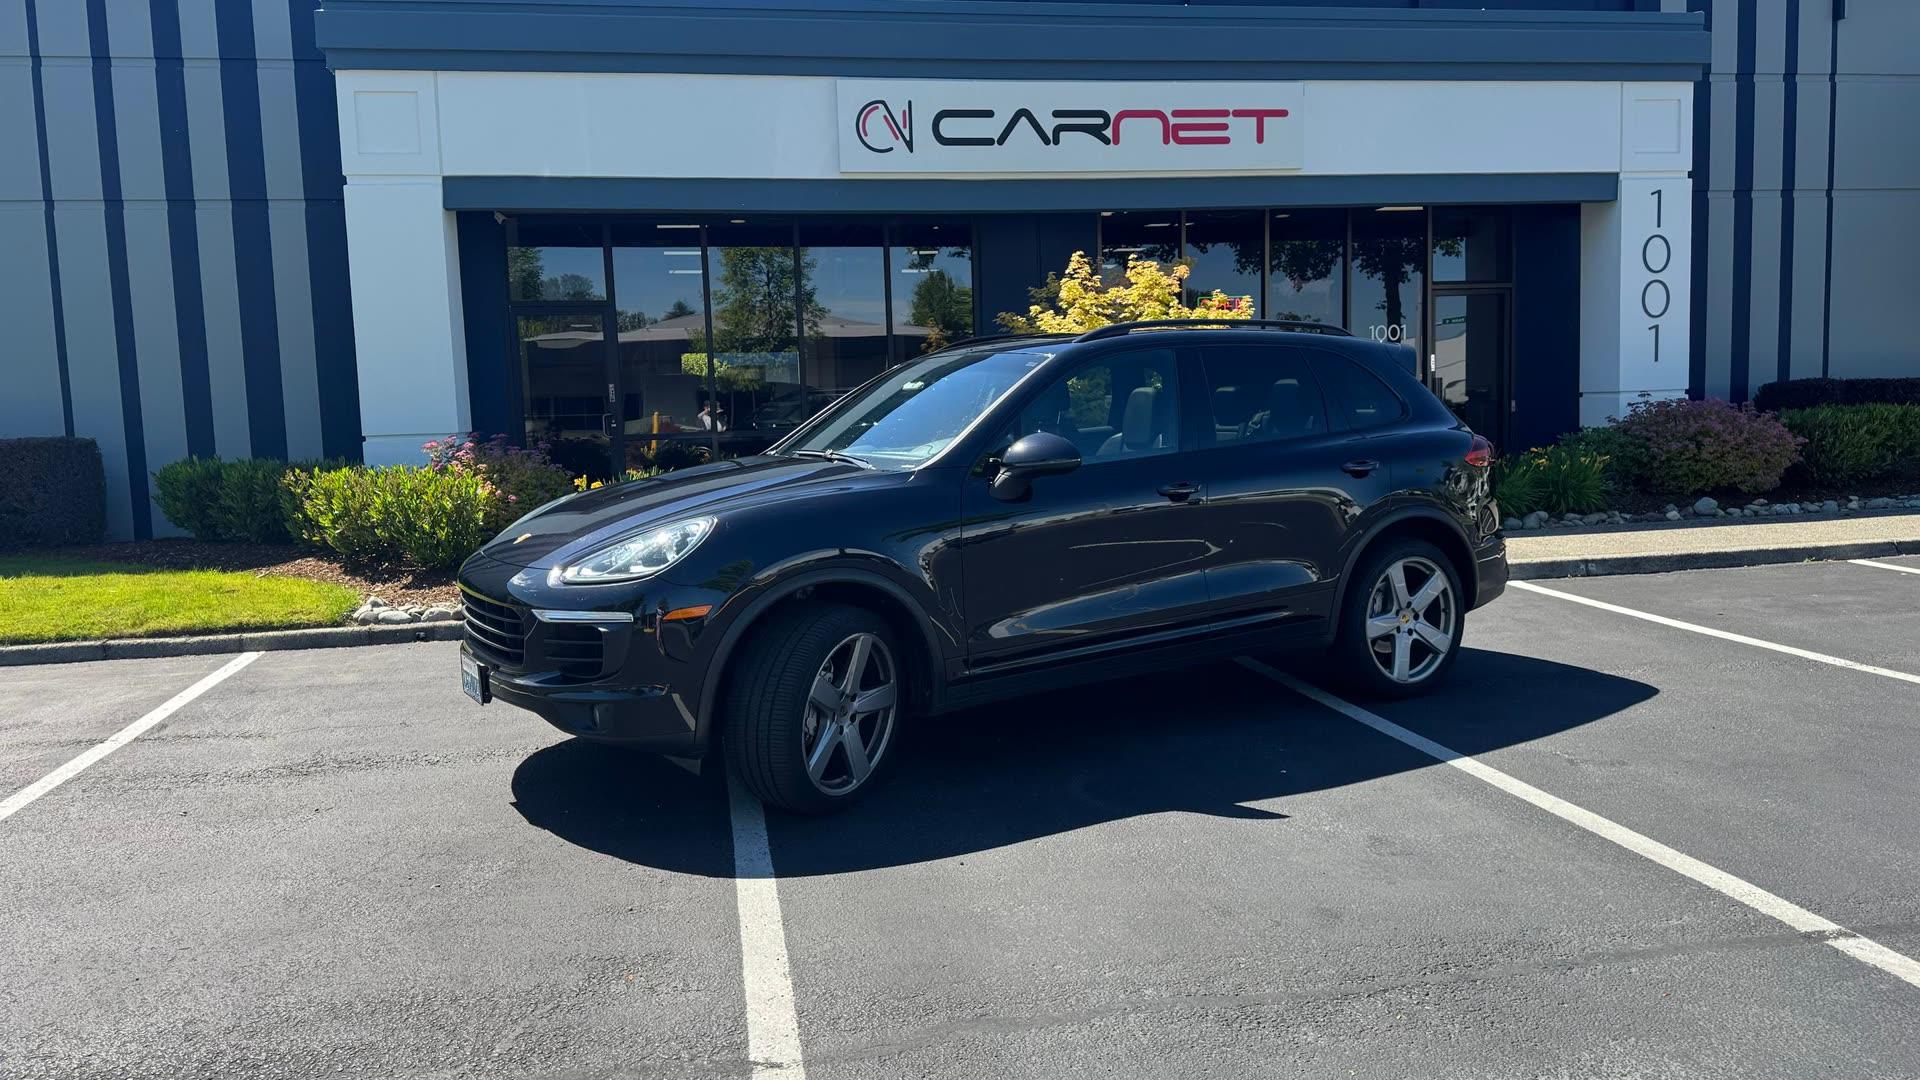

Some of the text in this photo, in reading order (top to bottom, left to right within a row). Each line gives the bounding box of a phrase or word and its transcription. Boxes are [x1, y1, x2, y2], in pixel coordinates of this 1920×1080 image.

[932, 108, 1289, 146] CARNET
[1642, 189, 1671, 362] 1001
[1369, 324, 1406, 341] 1001
